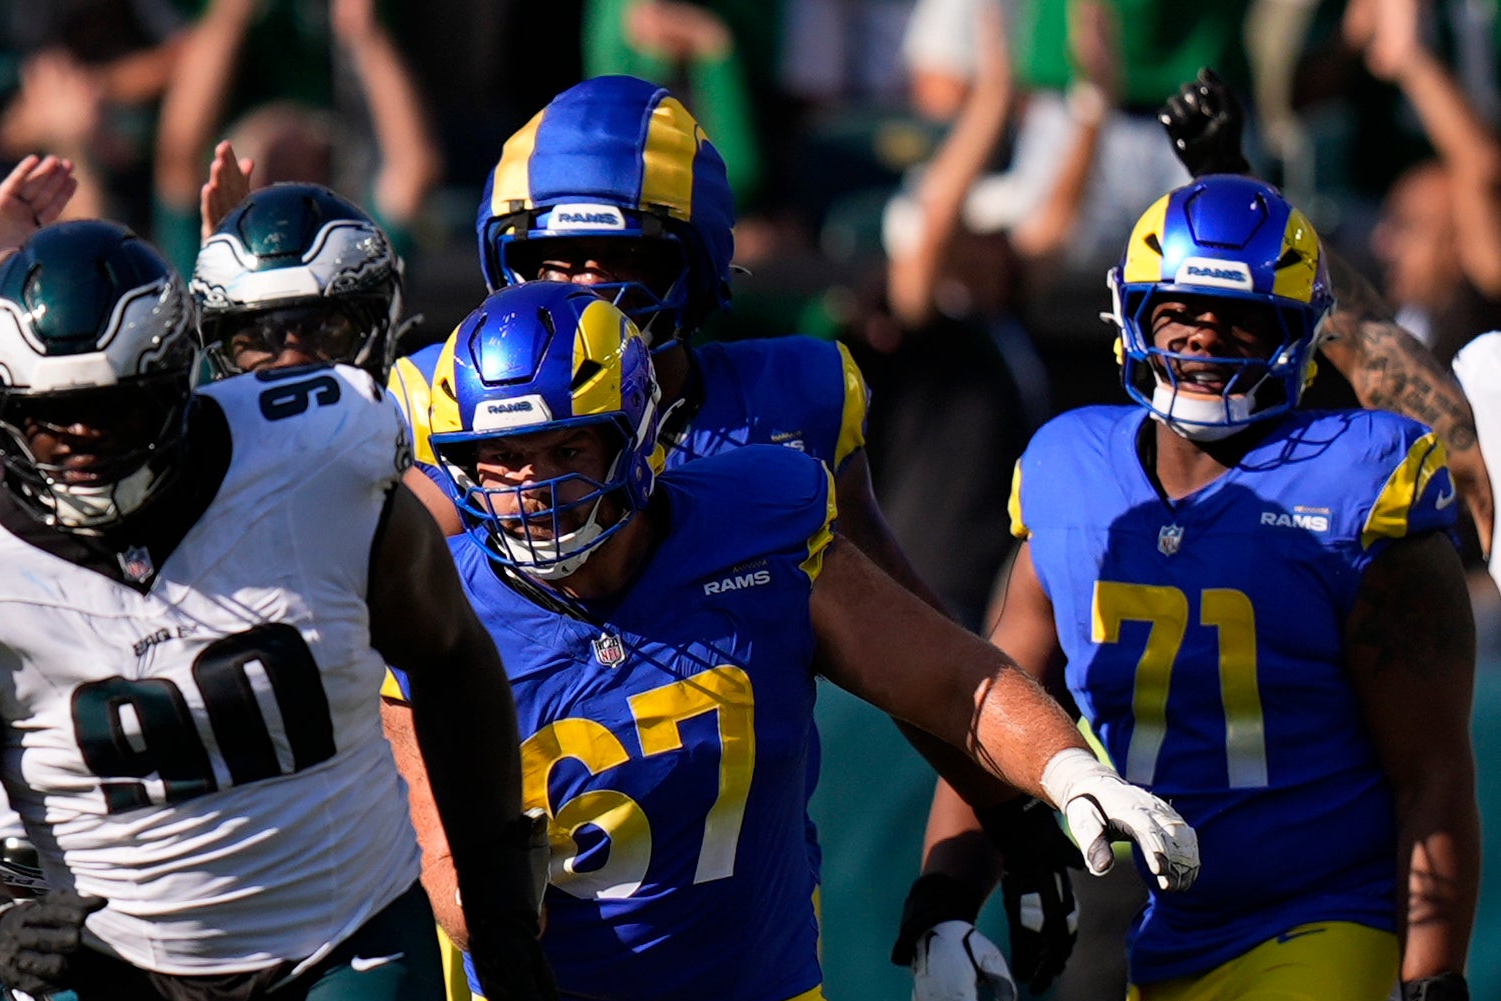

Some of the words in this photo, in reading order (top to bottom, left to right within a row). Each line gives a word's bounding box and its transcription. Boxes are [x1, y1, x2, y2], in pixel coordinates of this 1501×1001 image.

[487, 400, 534, 414] RAMS
[1261, 512, 1330, 532] RAMS
[704, 570, 771, 595] RAMS
[70, 622, 338, 815] 90
[1092, 580, 1269, 789] 71
[519, 663, 756, 901] 67
